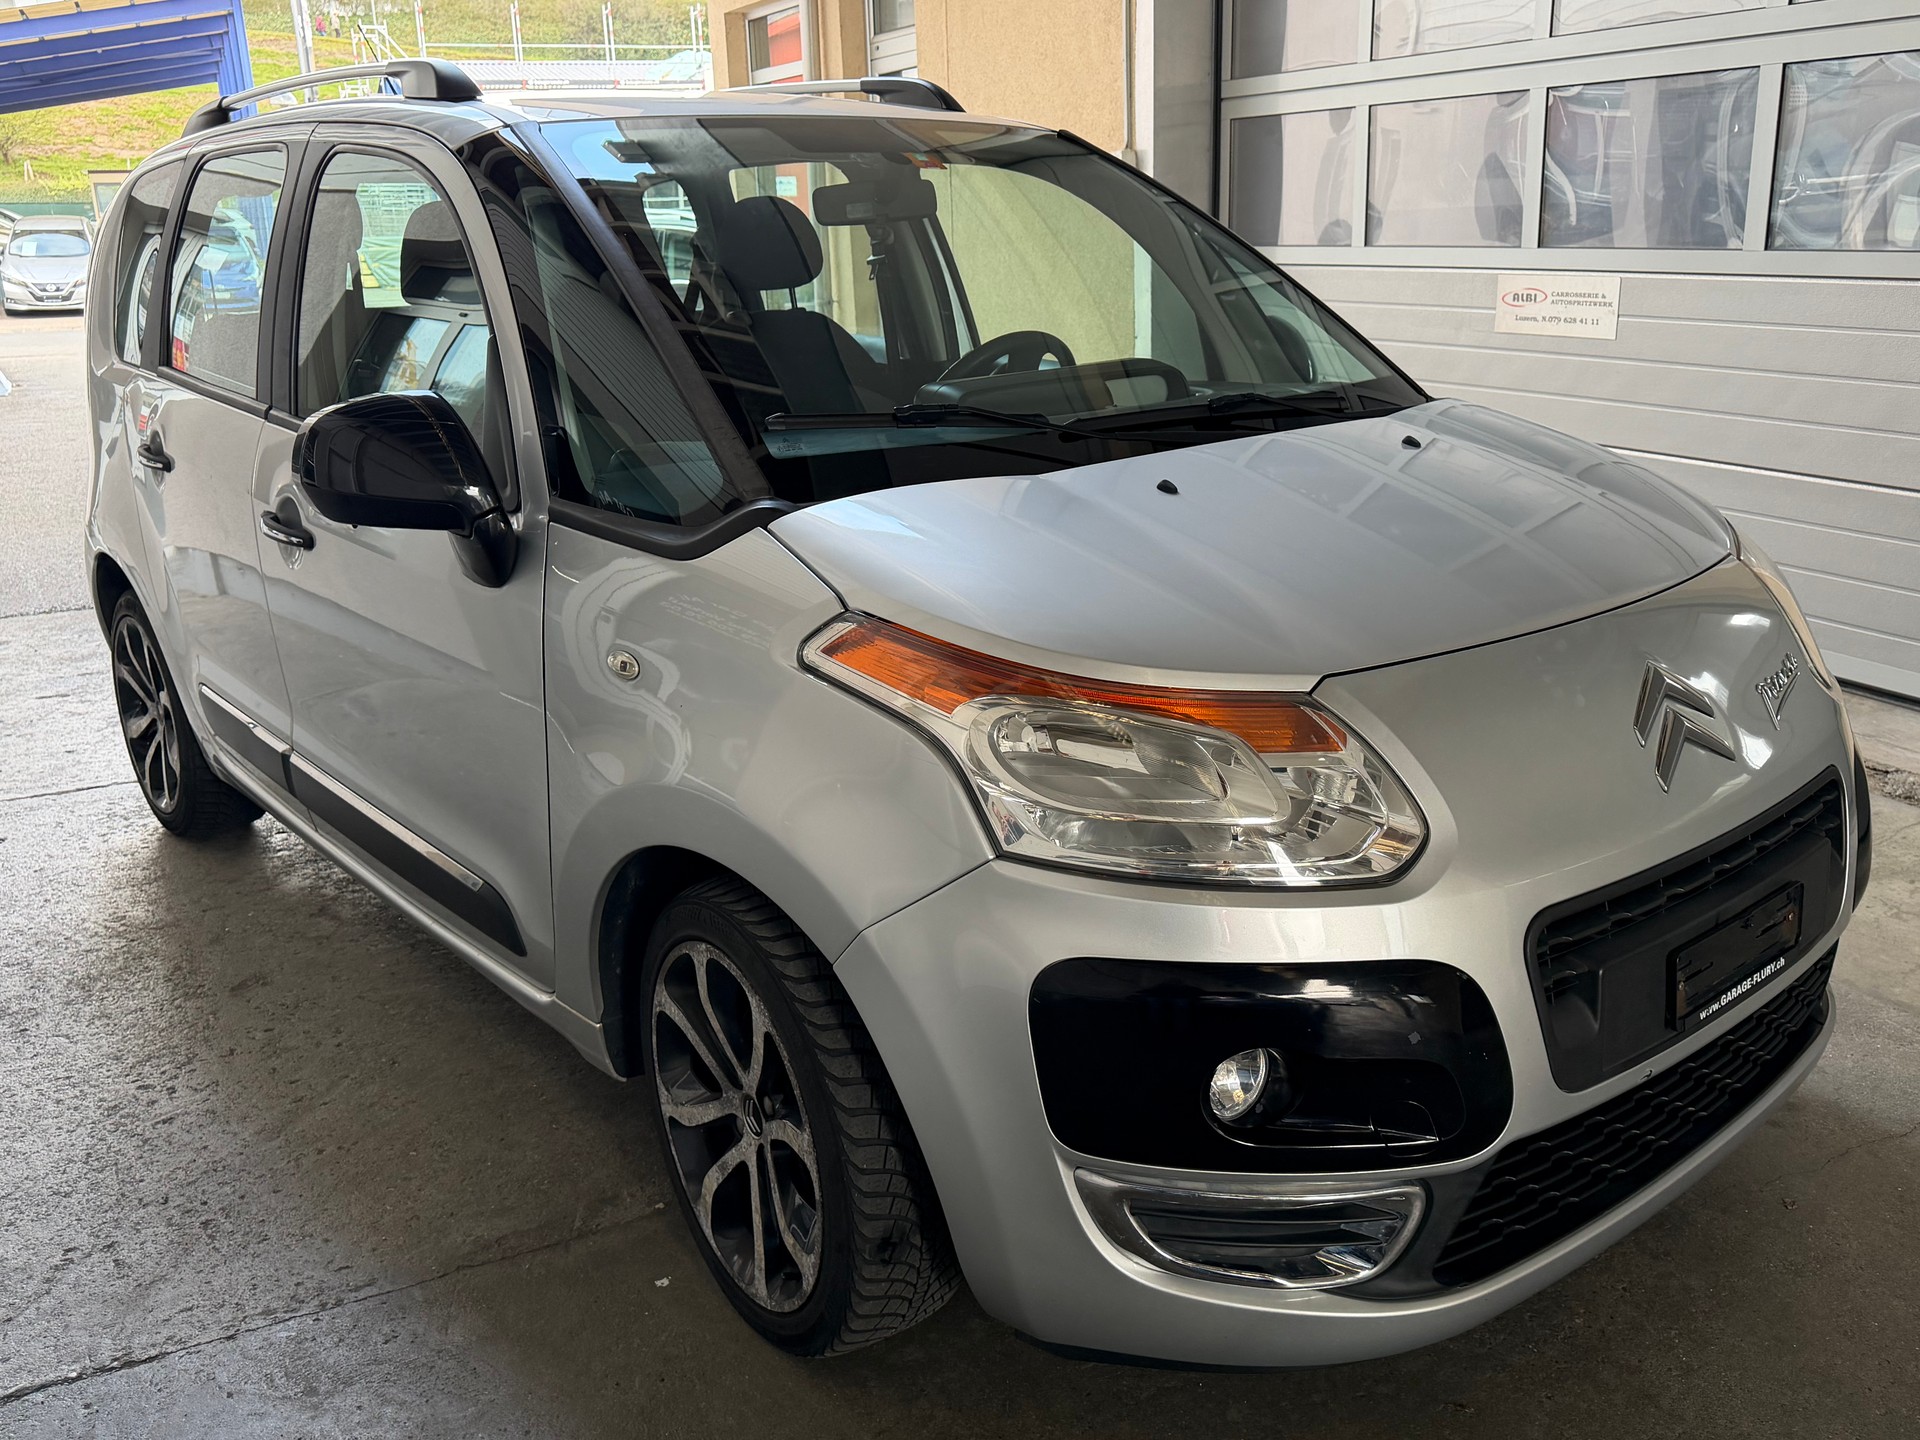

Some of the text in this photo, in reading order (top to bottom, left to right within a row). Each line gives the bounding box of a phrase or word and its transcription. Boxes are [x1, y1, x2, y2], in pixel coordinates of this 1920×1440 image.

[1512, 292, 1538, 304] ALBI
[1551, 291, 1600, 299] CARROSSERIE
[1550, 299, 1614, 308] AUTOSPRITZWERK
[1579, 317, 1588, 325] 41
